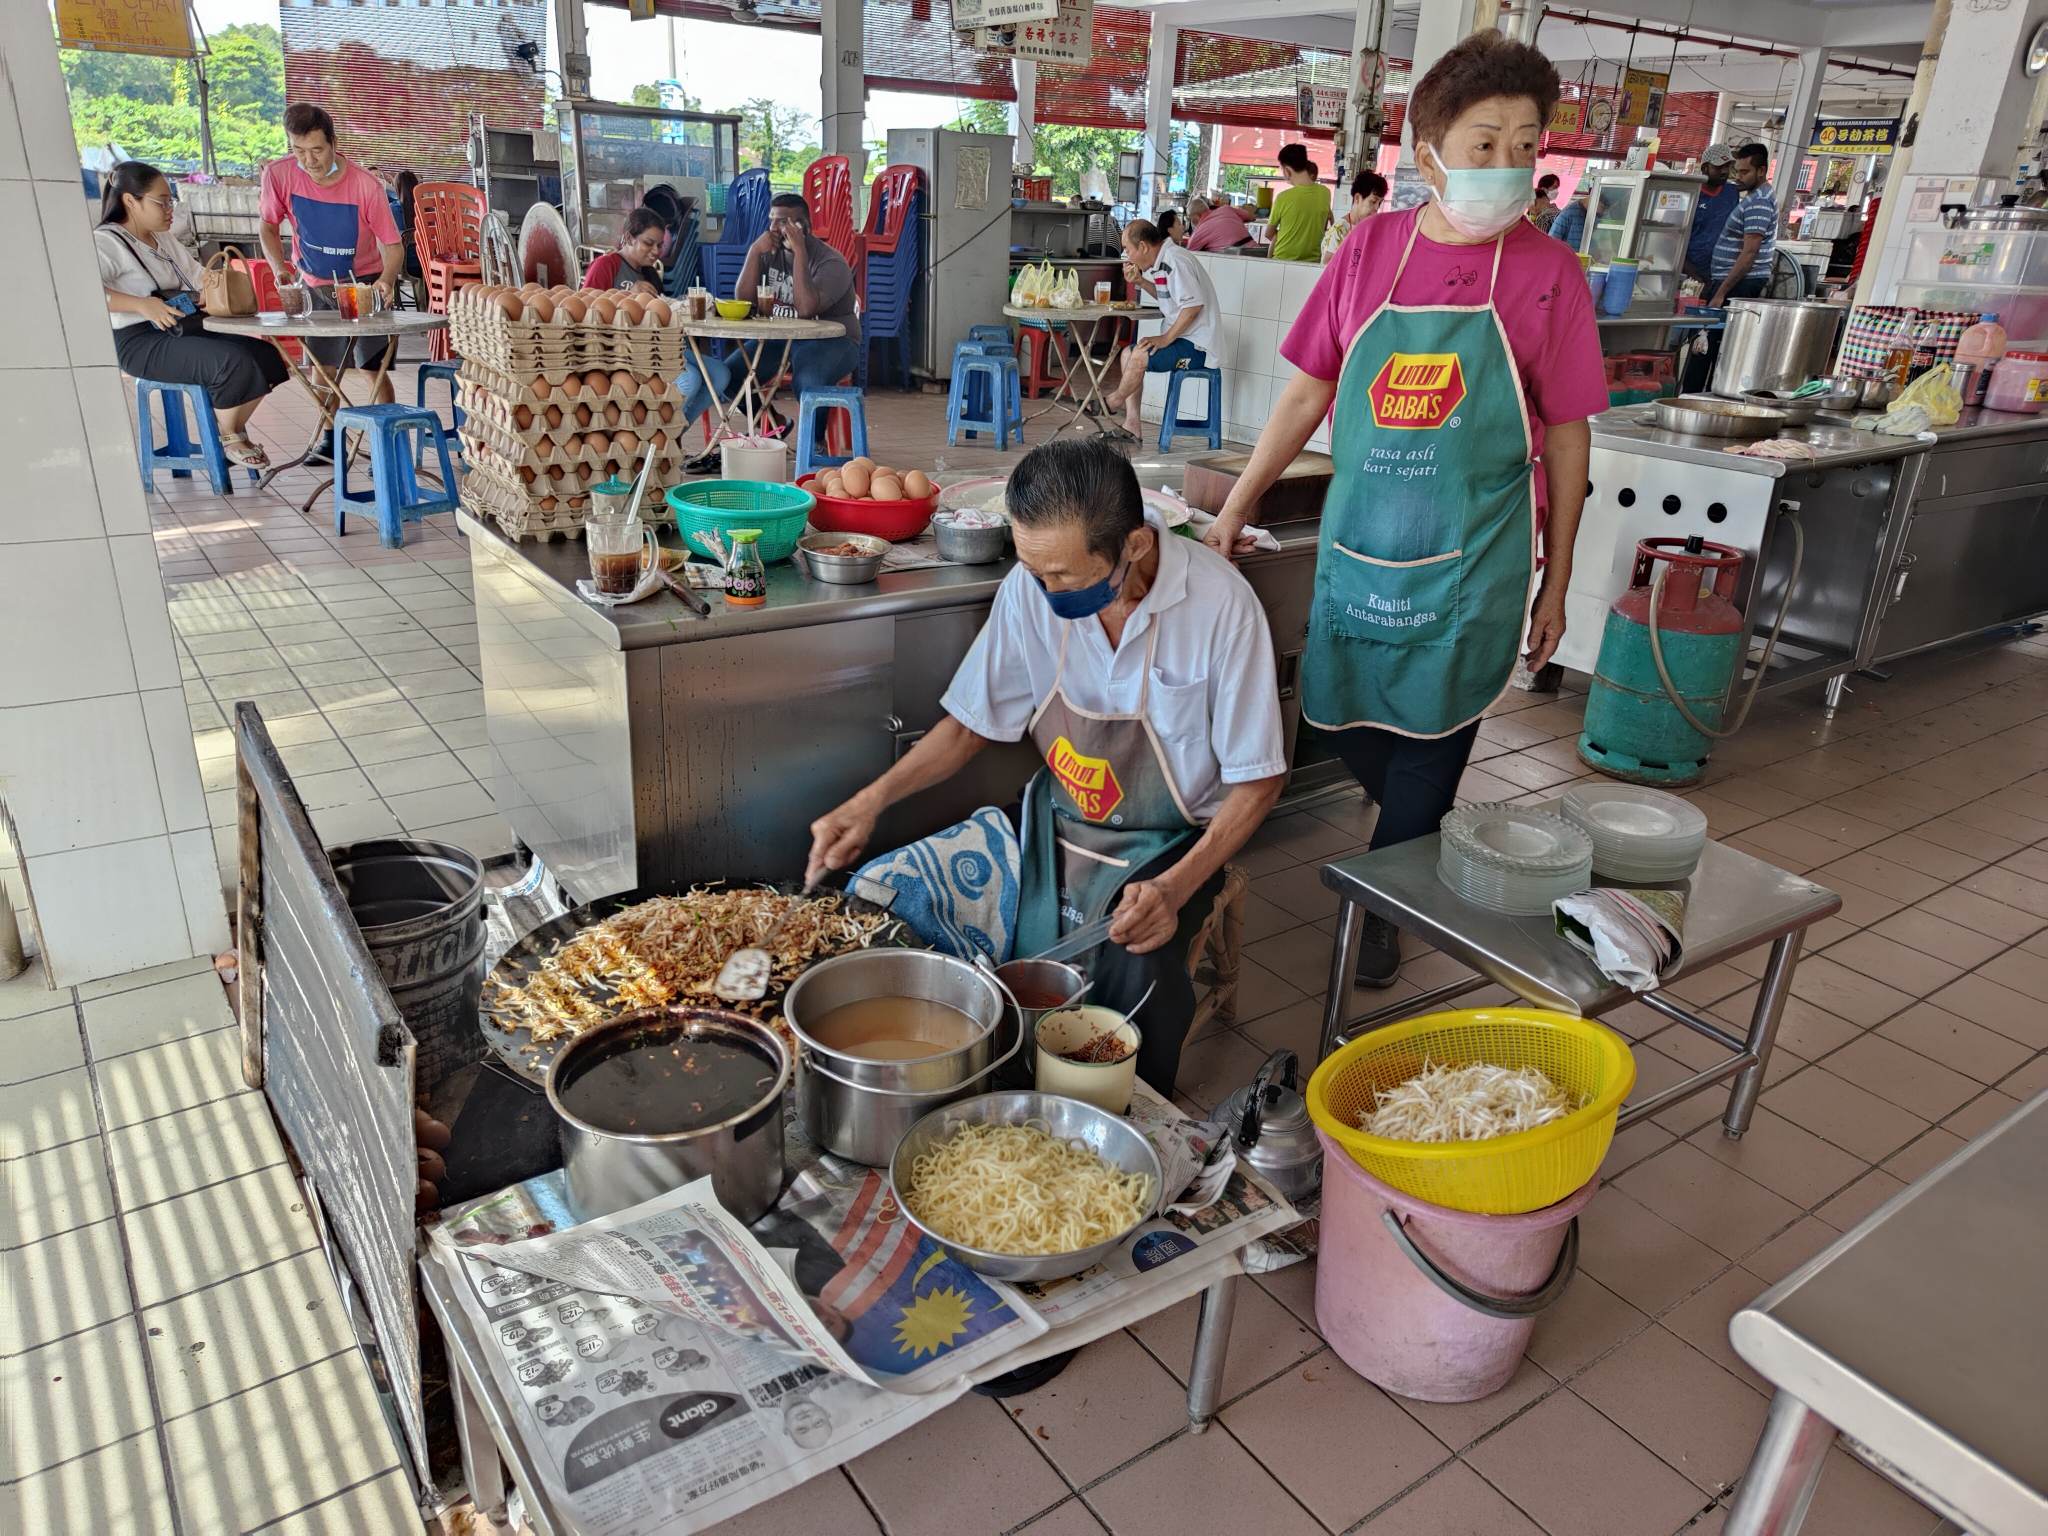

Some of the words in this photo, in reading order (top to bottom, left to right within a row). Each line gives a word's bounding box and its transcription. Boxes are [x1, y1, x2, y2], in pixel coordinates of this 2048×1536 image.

[1381, 393, 1442, 419] BABA'S
[1370, 447, 1401, 460] rasa
[1406, 443, 1436, 460] asli
[1363, 459, 1392, 475] kari
[1395, 464, 1439, 481] sejati
[1368, 593, 1412, 612] Kualiti
[1345, 603, 1437, 627] Antarabangsa
[668, 1399, 717, 1427] Giant
[580, 1425, 651, 1468] 生鲜优惠
